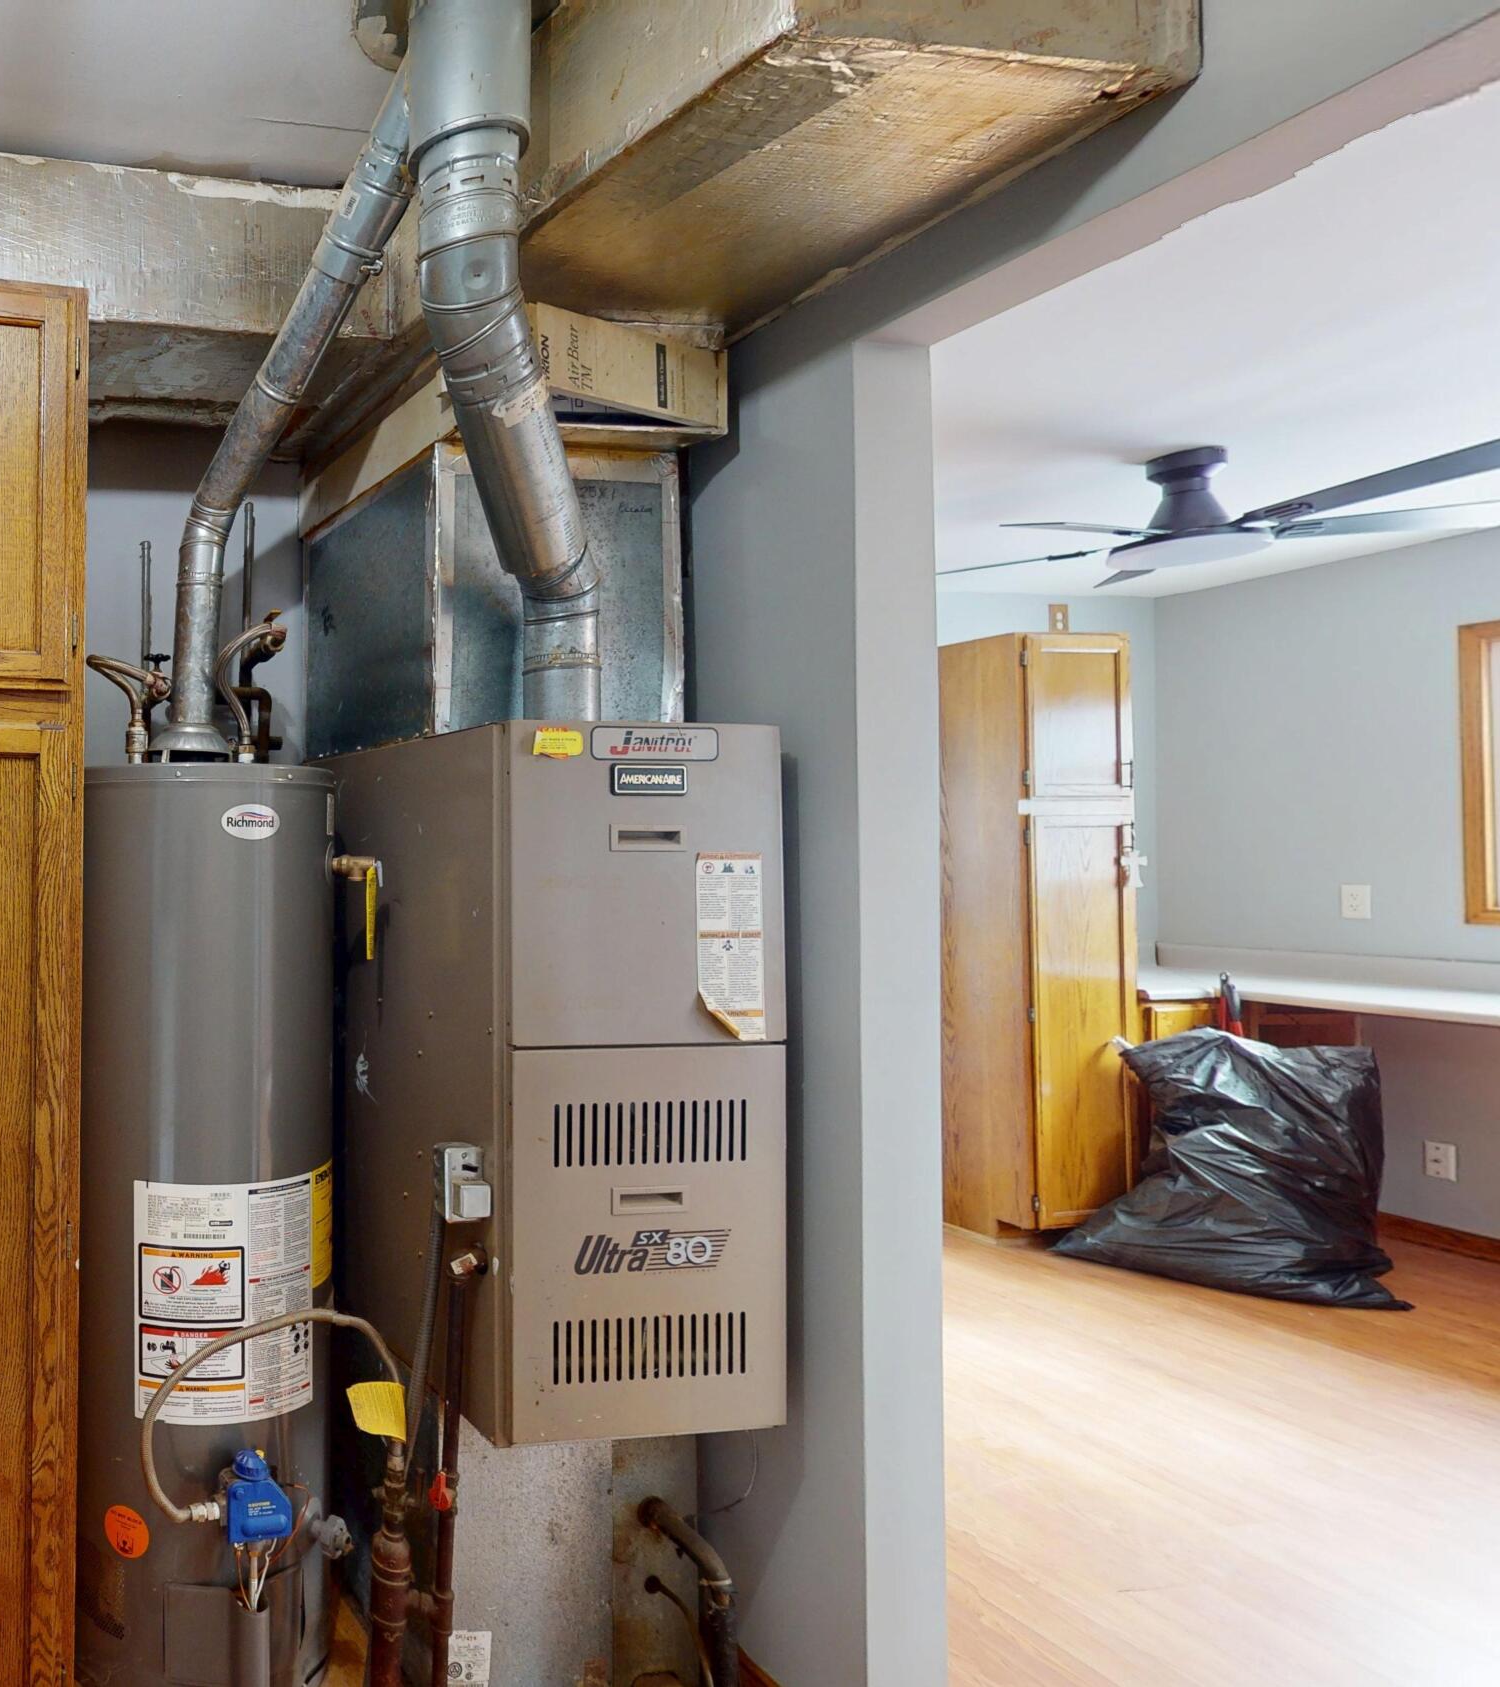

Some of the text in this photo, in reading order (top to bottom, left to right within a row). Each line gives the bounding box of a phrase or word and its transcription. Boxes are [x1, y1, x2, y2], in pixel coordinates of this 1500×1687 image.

[540, 334, 550, 380] RION
[567, 324, 580, 389] Air Bear
[226, 816, 275, 828] Richmond
[178, 1251, 214, 1259] WARNING
[574, 1231, 713, 1275] Ultra SX 80
